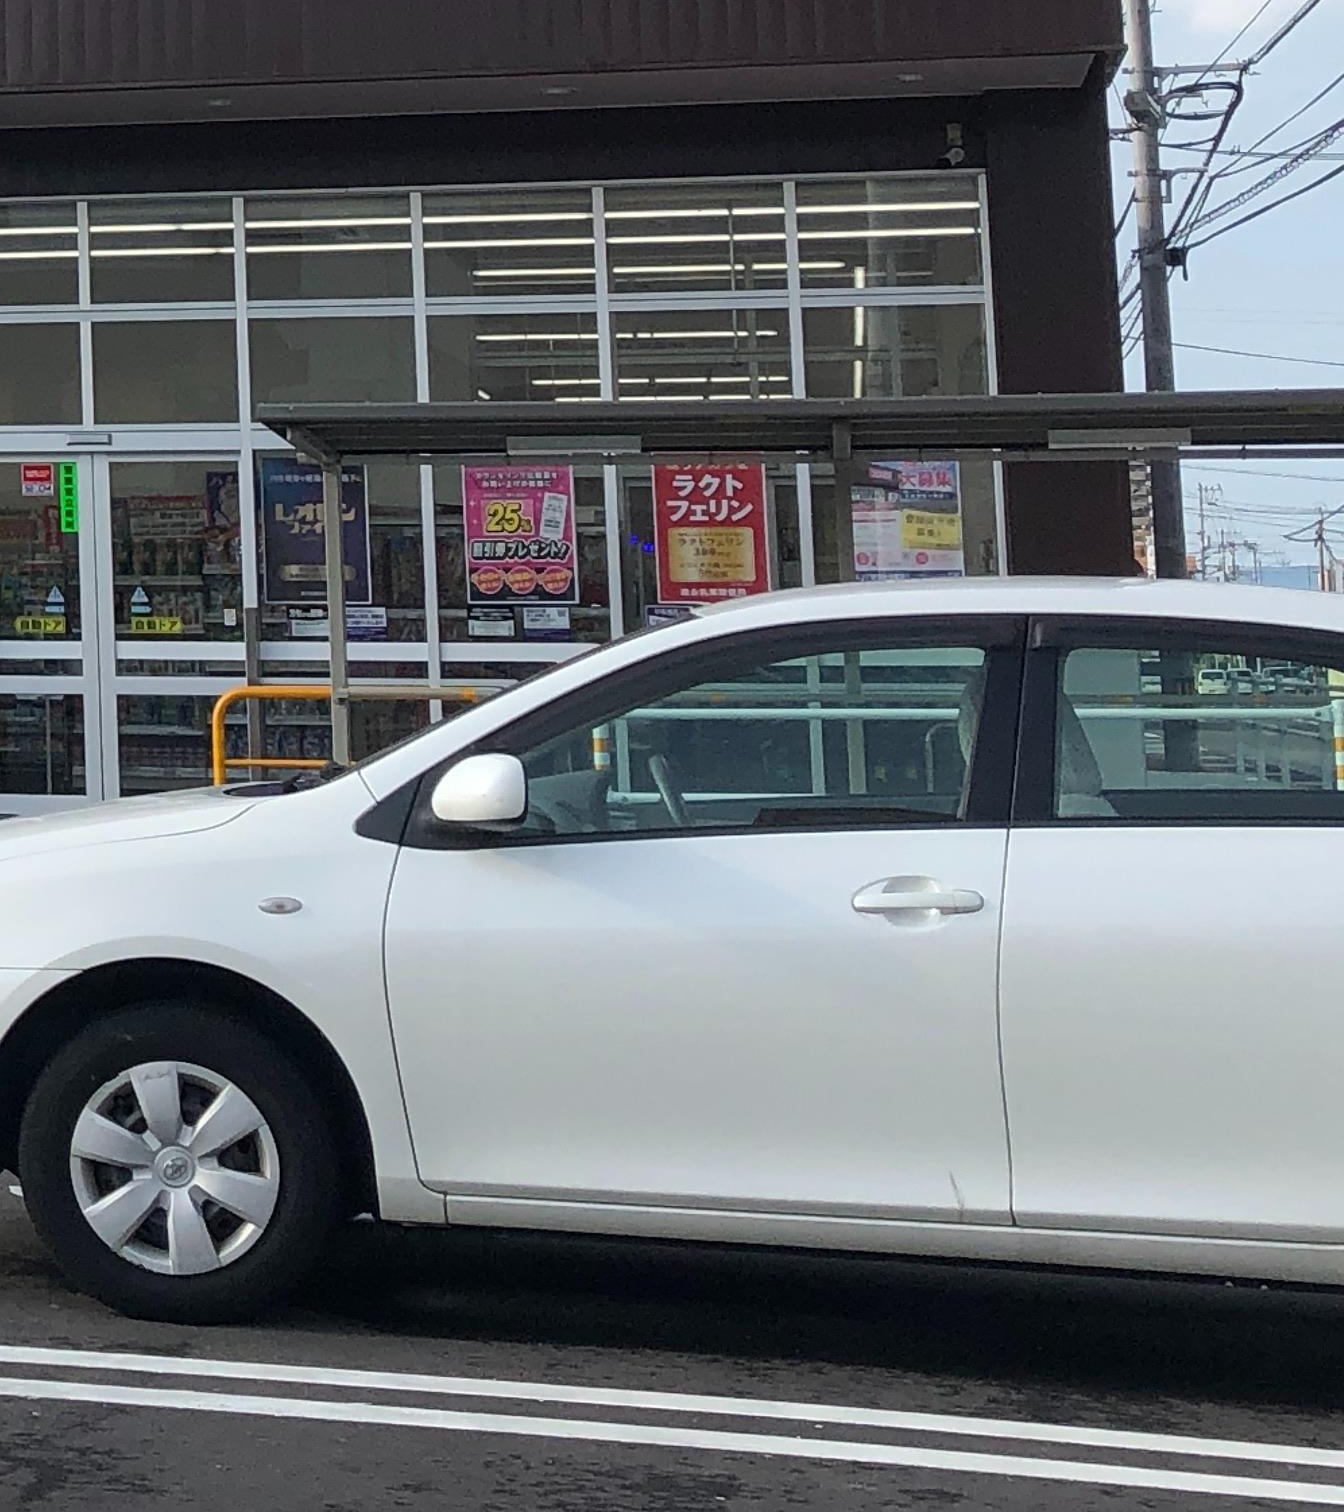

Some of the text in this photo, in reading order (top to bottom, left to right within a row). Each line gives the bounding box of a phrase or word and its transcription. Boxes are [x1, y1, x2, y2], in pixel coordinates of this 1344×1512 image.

[672, 473, 744, 497] ラクト
[666, 499, 754, 522] フェリン
[20, 619, 62, 631] 自動ドア
[135, 620, 178, 631] 自動ドア
